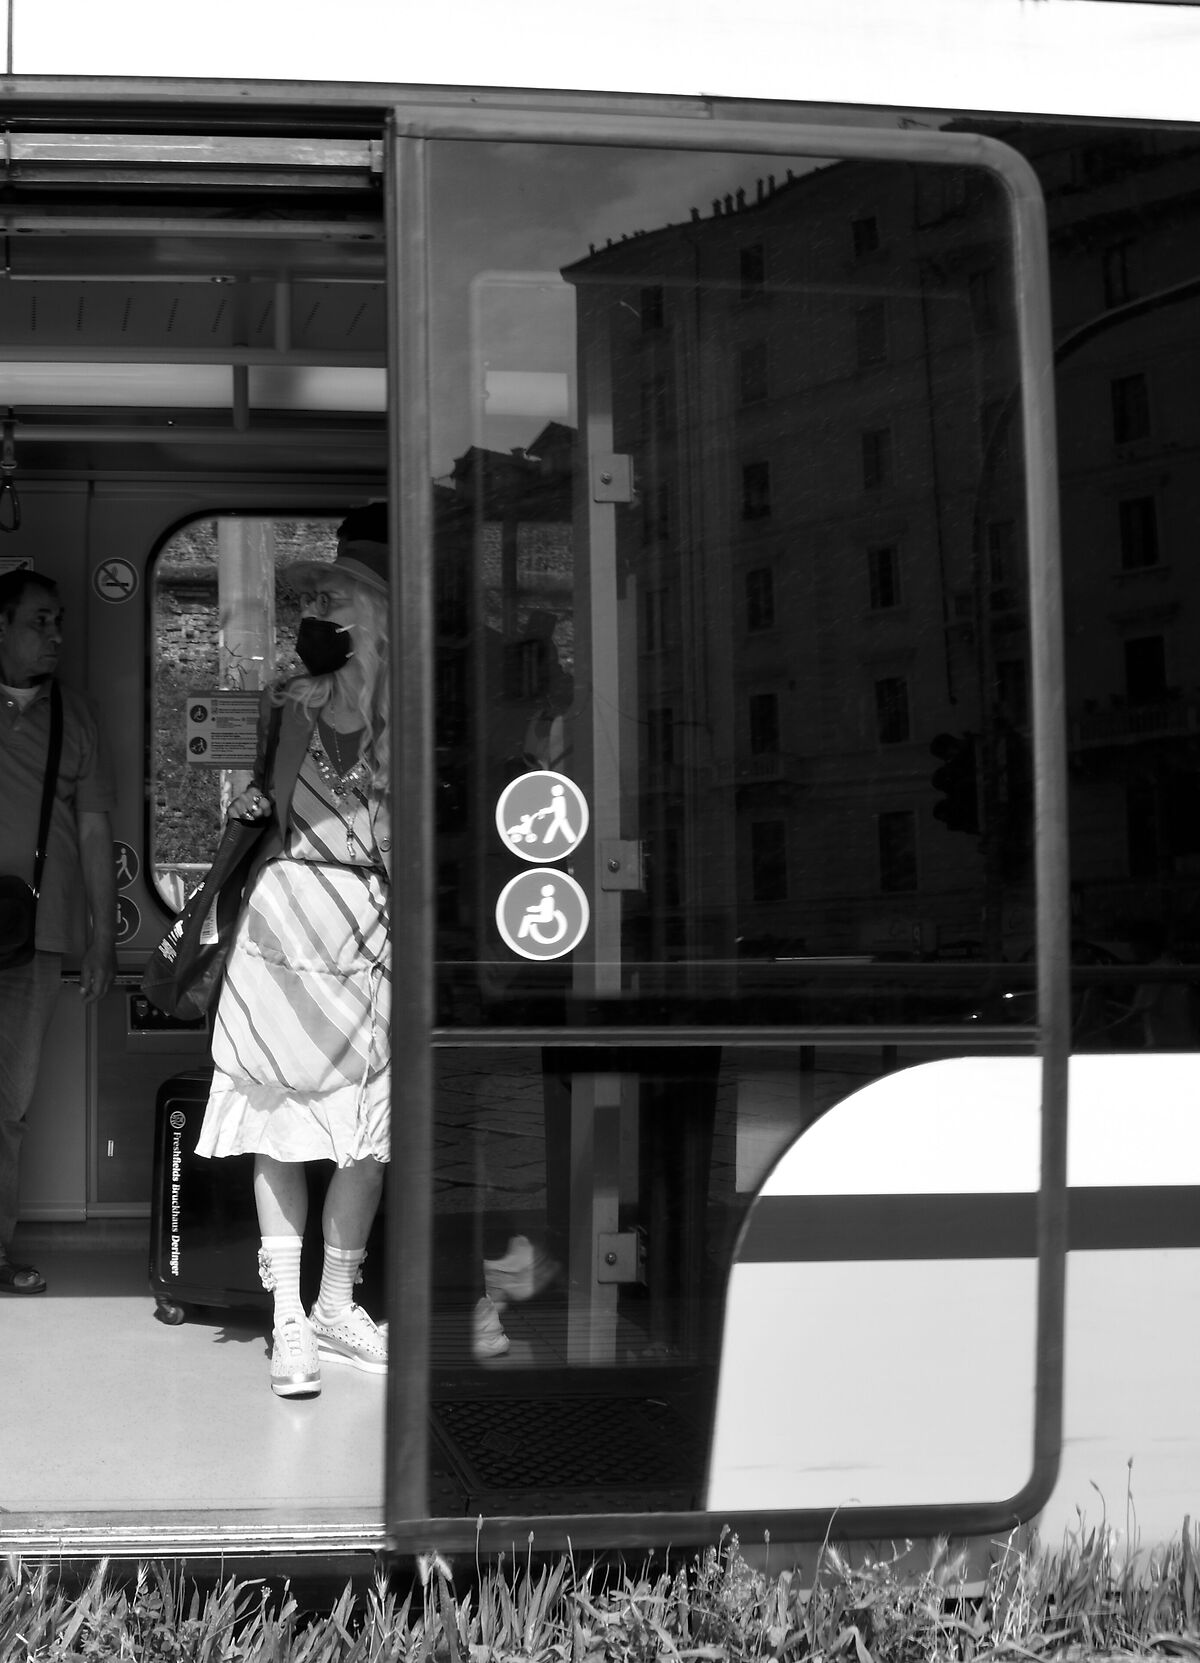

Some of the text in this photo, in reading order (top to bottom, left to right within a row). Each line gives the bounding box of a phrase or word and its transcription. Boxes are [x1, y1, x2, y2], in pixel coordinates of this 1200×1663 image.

[169, 1132, 181, 1276] Freshfields Bruckhaus Deringer
